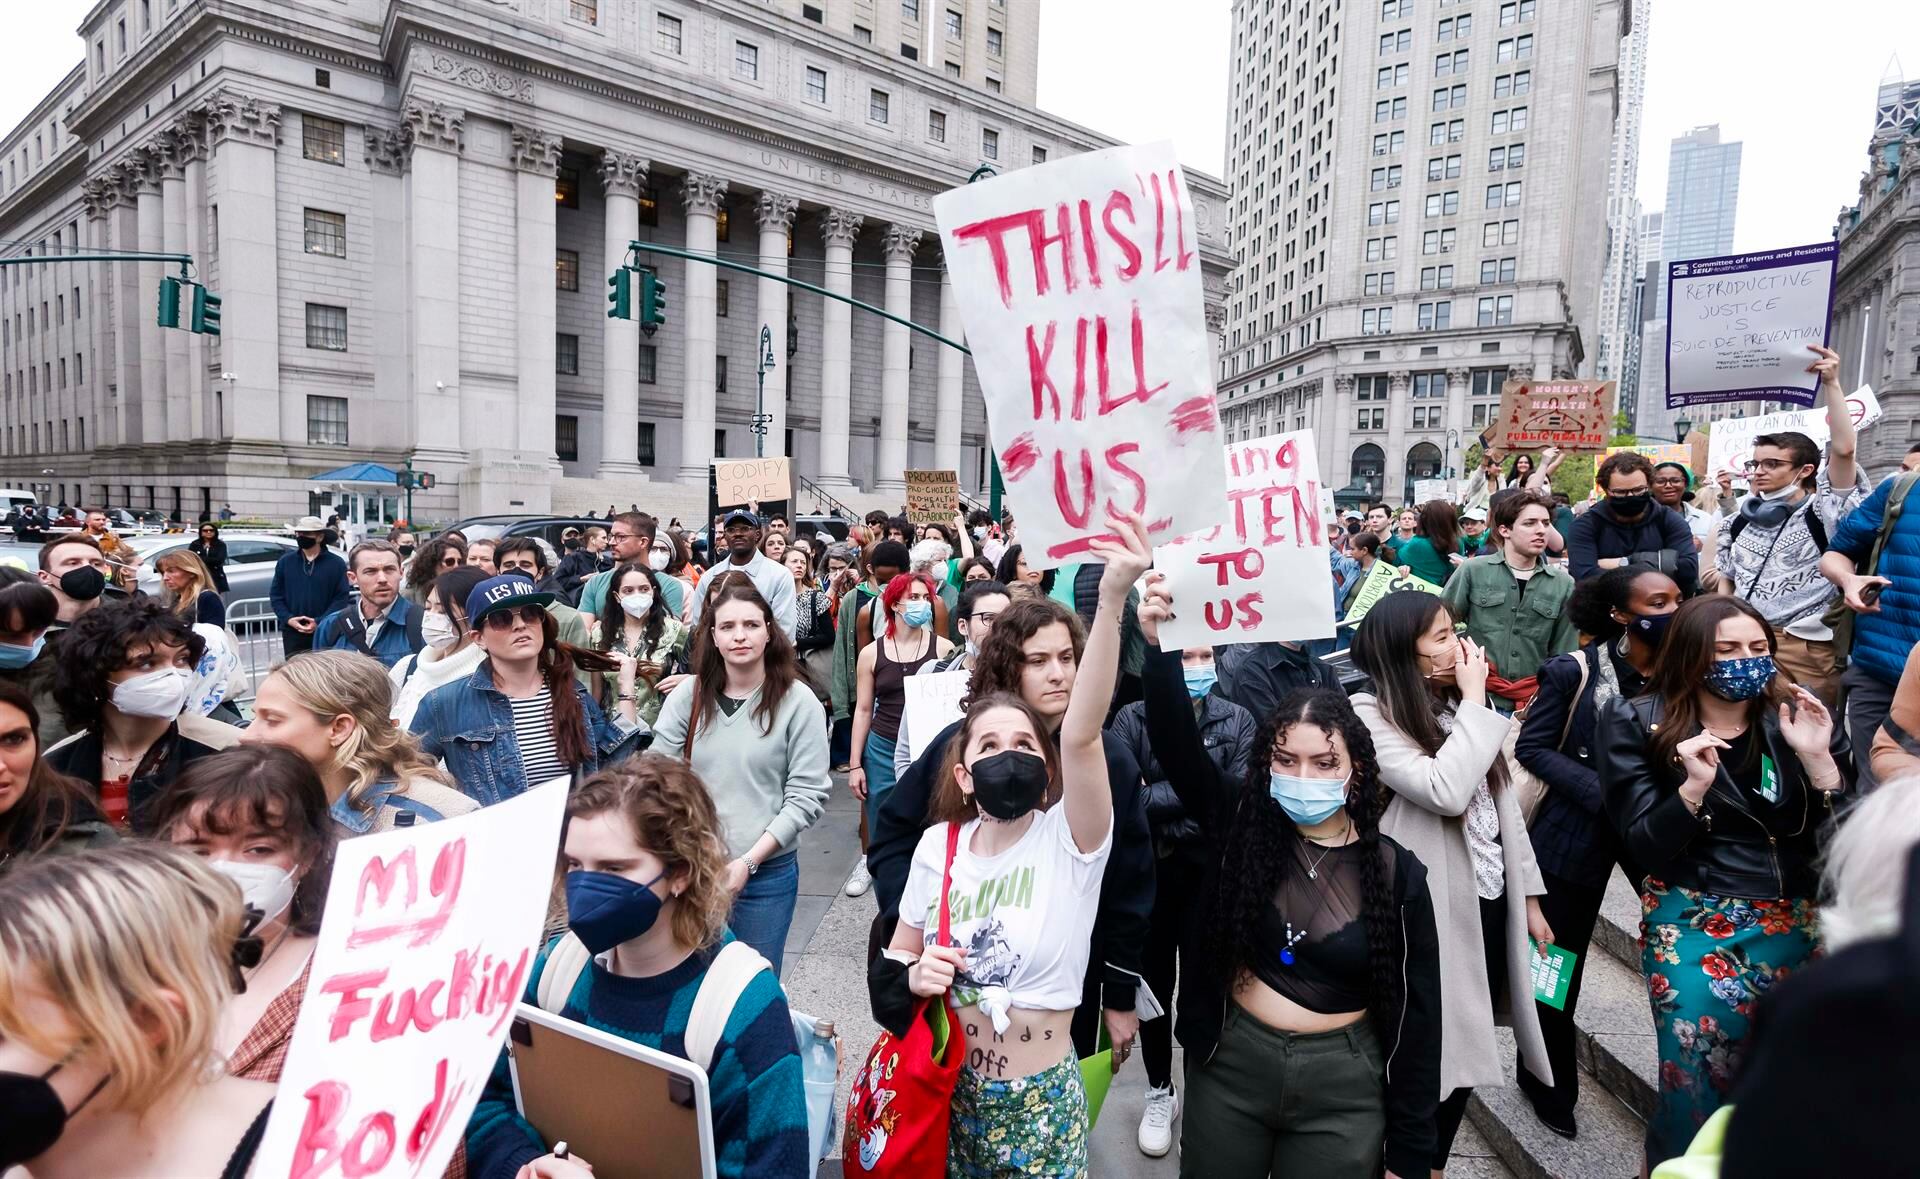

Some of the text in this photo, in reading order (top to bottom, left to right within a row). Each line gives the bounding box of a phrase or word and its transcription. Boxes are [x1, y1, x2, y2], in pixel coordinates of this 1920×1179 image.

[761, 152, 929, 210] UNITED STATES
[1692, 259, 1734, 269] Committee
[1746, 254, 1774, 264] Interns
[1776, 251, 1792, 259] and
[1794, 245, 1835, 256] Residents
[1686, 269, 1820, 300] REPRODUCTIVE
[1699, 296, 1780, 320] JUSTICE
[1671, 326, 1823, 353] SUICIDE PREVENTION
[1026, 299, 1168, 423] KILL
[1535, 385, 1589, 394] WOMEN'S
[1783, 388, 1814, 399] Residents
[1532, 401, 1587, 410] HEALTH
[1718, 421, 1747, 434] YOU
[1755, 417, 1779, 430] CAN
[1507, 432, 1602, 443] PUBLIC HEALTH
[718, 461, 784, 481] CODIFY
[732, 483, 777, 502] ROE
[907, 485, 956, 494] PRO-CHOICE
[1053, 442, 1146, 529] US
[1197, 547, 1265, 587] TO
[485, 581, 534, 604] LES NYC
[1204, 591, 1265, 631] US
[966, 1023, 1053, 1043] ands
[970, 1047, 1008, 1077] Off
